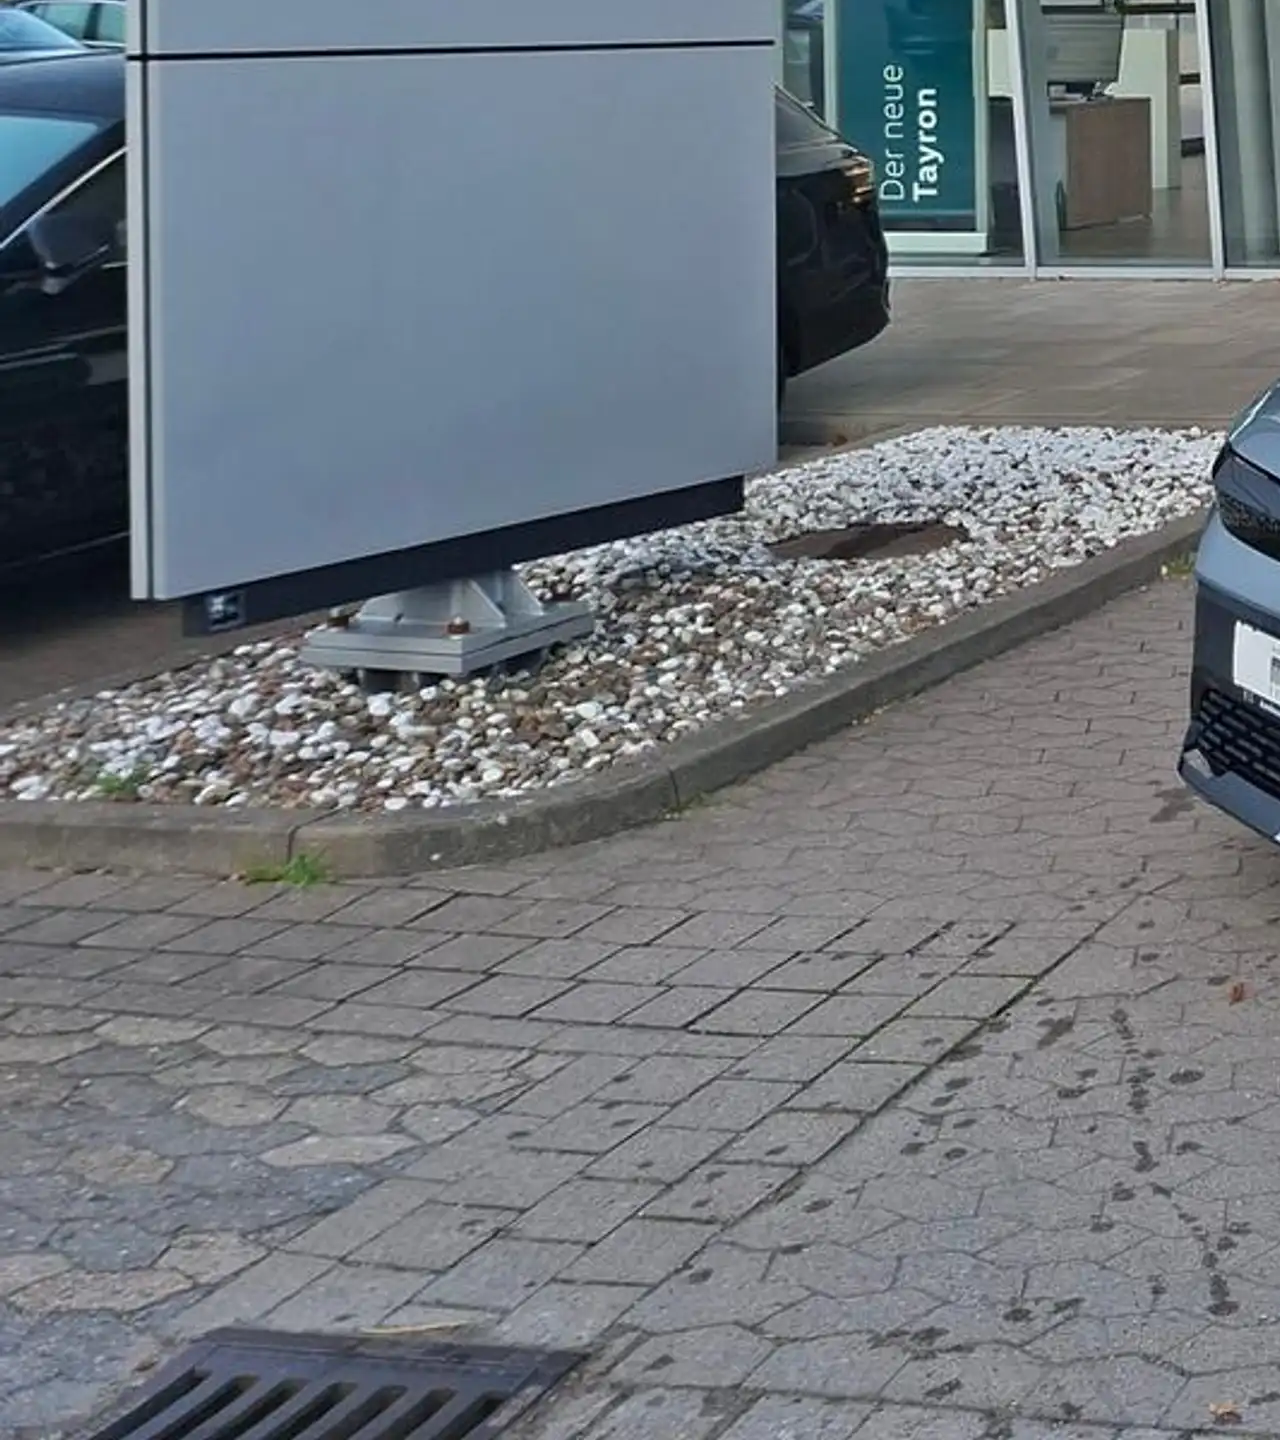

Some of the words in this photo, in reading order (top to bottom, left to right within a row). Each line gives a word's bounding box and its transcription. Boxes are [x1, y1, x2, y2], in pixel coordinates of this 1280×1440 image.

[883, 63, 904, 139] neue
[878, 148, 905, 201] Der
[911, 87, 945, 203] Tayron
